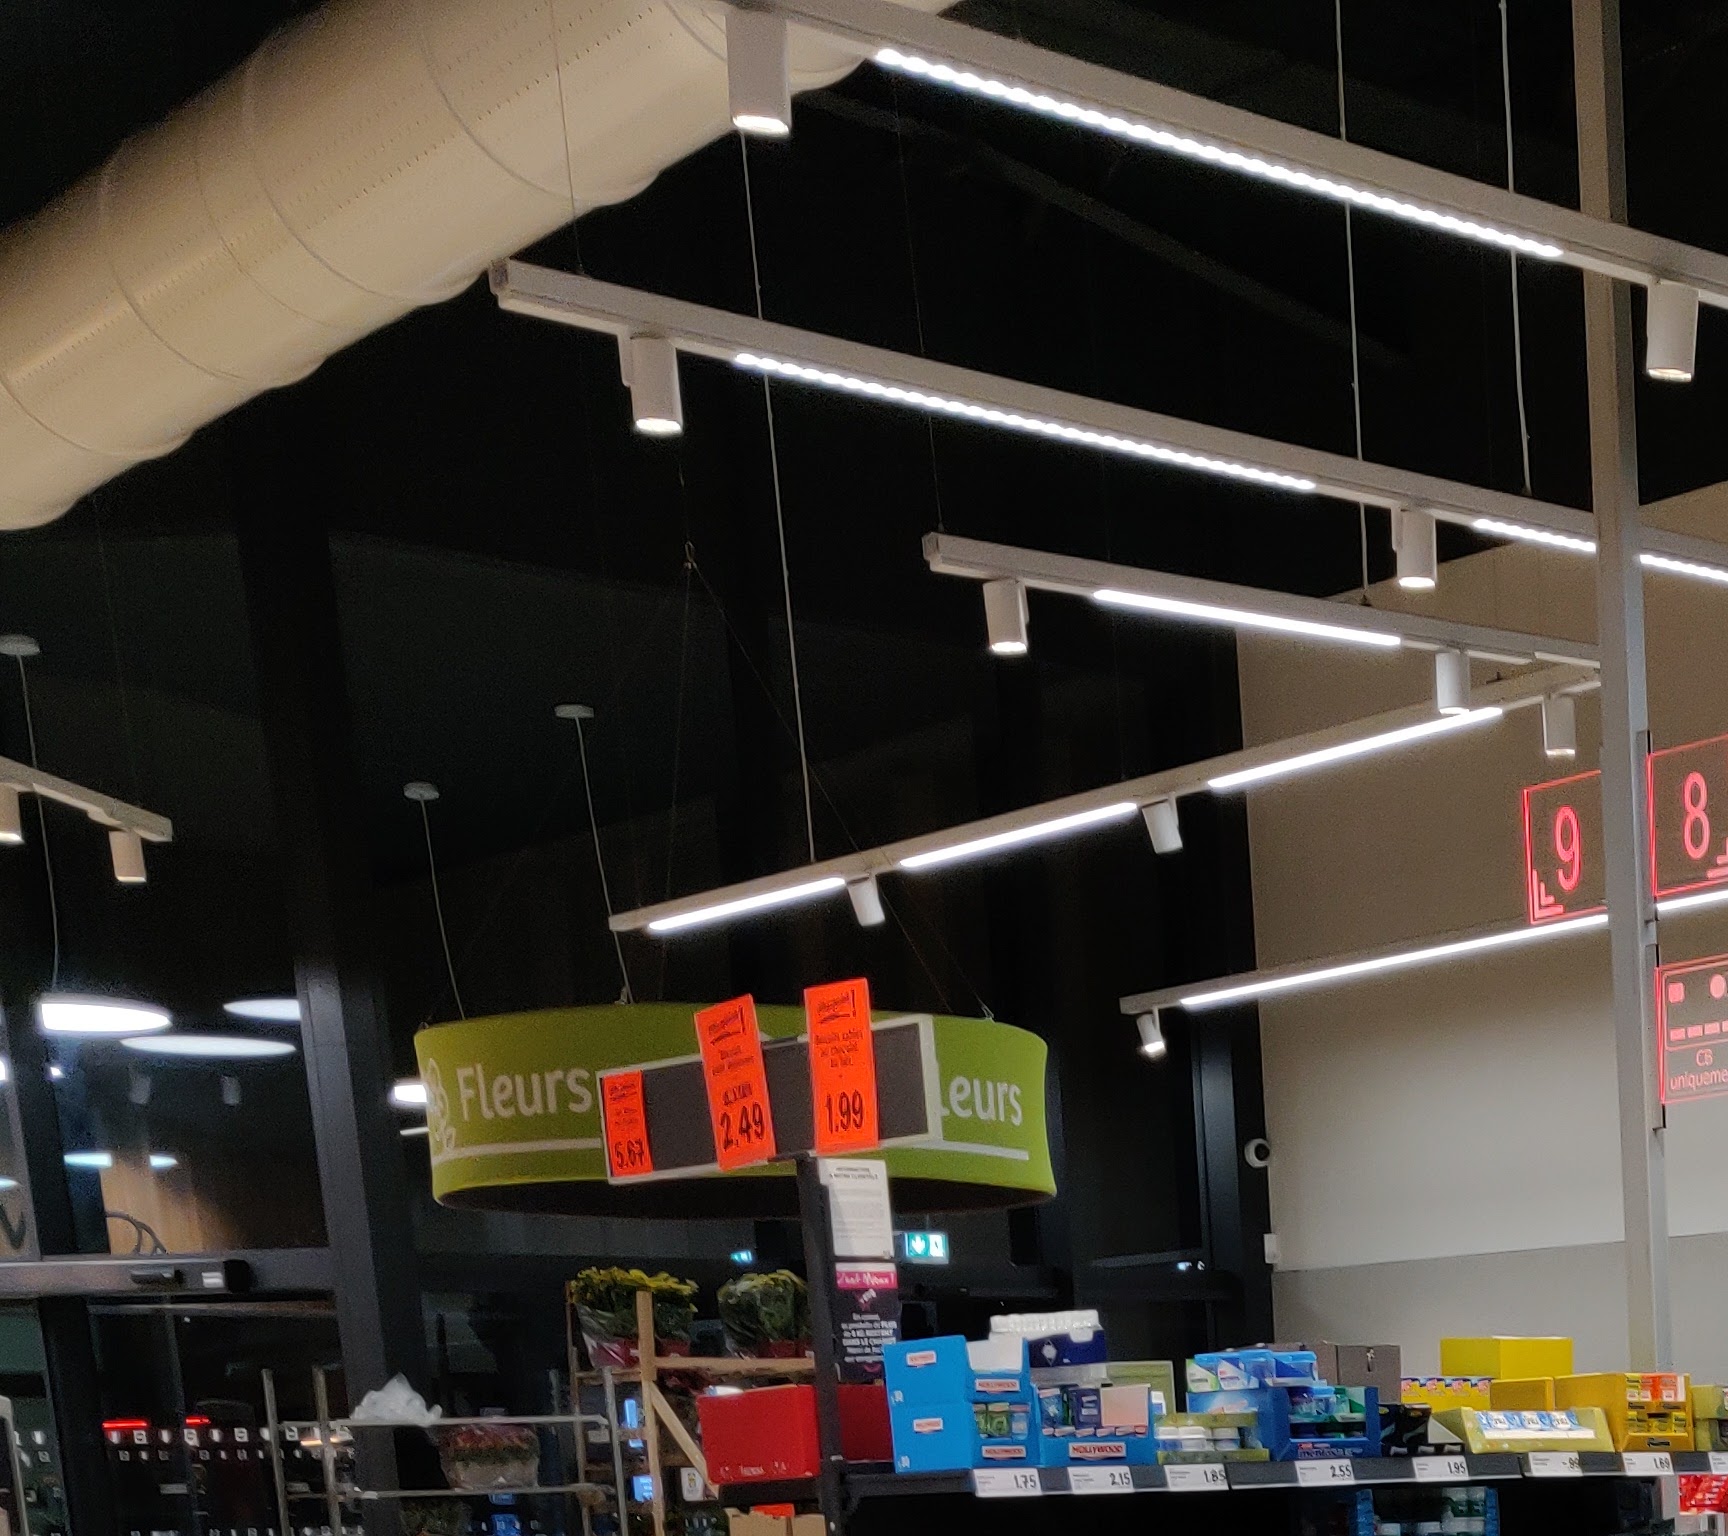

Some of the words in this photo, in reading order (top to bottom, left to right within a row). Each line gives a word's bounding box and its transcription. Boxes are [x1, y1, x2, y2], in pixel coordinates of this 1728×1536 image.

[1683, 772, 1710, 859] 8
[1555, 806, 1581, 890] 9
[1695, 1049, 1713, 1068] CB
[456, 1065, 592, 1122] Fleurs
[825, 1090, 864, 1134] 1.99
[941, 1076, 1022, 1127] eurs
[720, 1101, 764, 1150] 2.49
[1014, 1474, 1037, 1489] 1.75
[1109, 1472, 1131, 1486] 2.15
